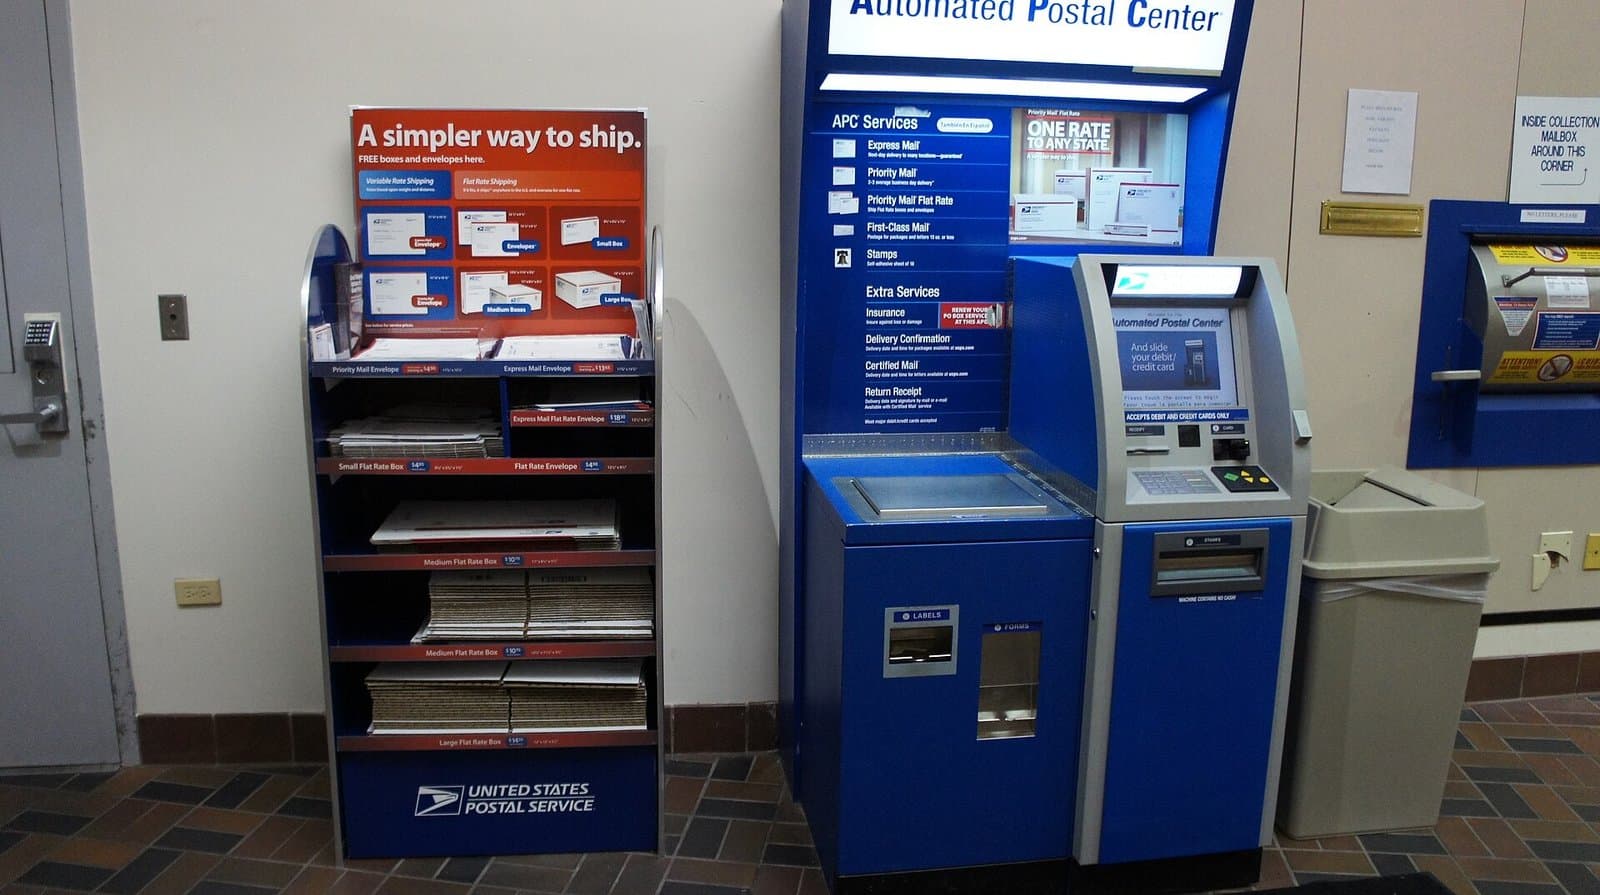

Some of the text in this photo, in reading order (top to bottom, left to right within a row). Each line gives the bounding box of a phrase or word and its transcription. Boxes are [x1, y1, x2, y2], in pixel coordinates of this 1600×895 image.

[1028, 0, 1114, 26] Postal
[1127, 0, 1218, 32] Center
[832, 114, 918, 130] APC Services
[1522, 115, 1600, 128] INSIDE COLLECTION
[1028, 120, 1111, 138] ONE RATE
[358, 123, 642, 153] A simpler way to ship.
[1541, 131, 1577, 142] MAILBOX
[868, 140, 920, 151] Express Mail
[1027, 137, 1044, 149] TO
[1046, 138, 1072, 149] ANY
[1531, 146, 1586, 157] AROUND THIS
[358, 155, 486, 165] FREE boxes and envelopes here.
[1541, 160, 1574, 172] CORNER
[868, 168, 917, 179] Priority Mail
[407, 178, 435, 186] Shipping
[490, 178, 518, 187] Shipping
[867, 195, 954, 206] Priority Mail Flat Rate
[867, 222, 930, 232] First-Class Mail
[867, 249, 898, 260] Stamps
[866, 286, 940, 298] Extra Services
[866, 308, 905, 317] Insurance
[1161, 318, 1190, 328] Postal
[1192, 318, 1224, 328] Center
[866, 334, 950, 345] Delivery Confirmation
[1131, 343, 1168, 352] And slide
[1132, 353, 1176, 363] your debit/
[332, 366, 356, 375] Priority
[370, 366, 399, 374] Envelope
[866, 360, 918, 370] Certified Mail
[1132, 362, 1174, 372] credit card
[865, 387, 922, 398] Return Receipt
[546, 463, 578, 471] Envelope
[468, 783, 590, 798] UNITED STATES
[465, 799, 594, 814] POSTAL SERVICE
